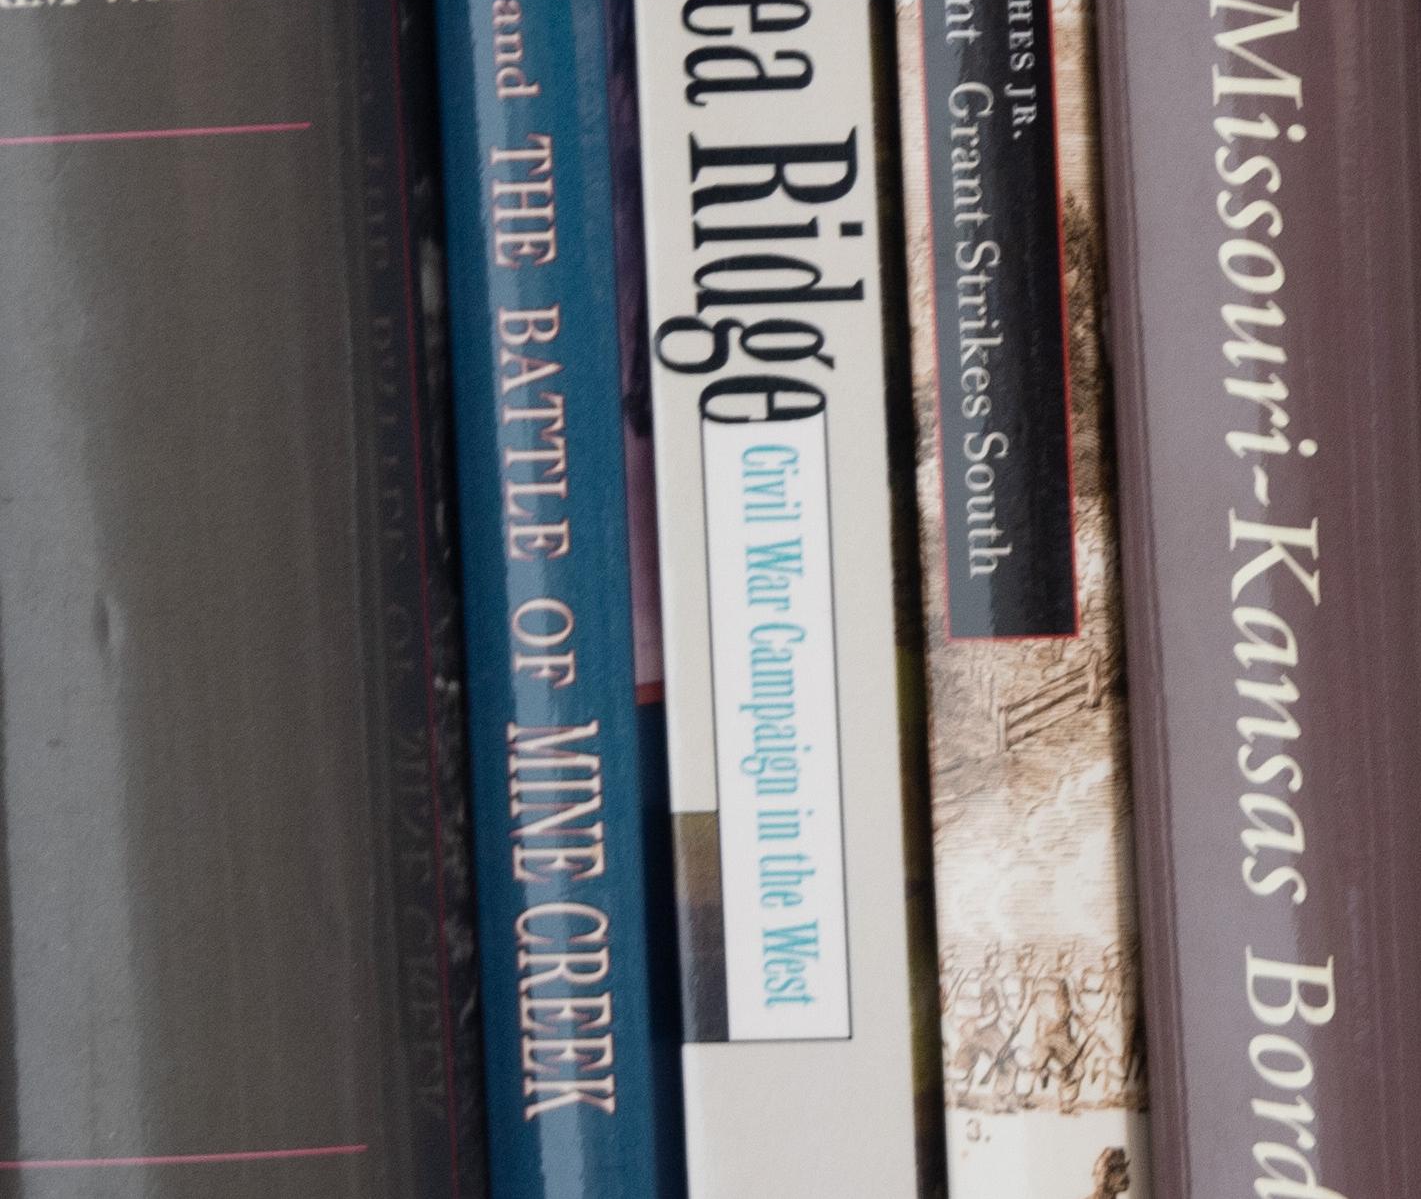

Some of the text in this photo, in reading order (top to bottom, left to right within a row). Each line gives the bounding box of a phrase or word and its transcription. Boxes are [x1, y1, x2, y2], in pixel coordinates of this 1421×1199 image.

[947, 82, 994, 230] Grant
[1009, 80, 1038, 140] JR.
[489, 133, 557, 269] THE
[654, 126, 866, 424] Ridge
[954, 238, 1005, 420] Strikes
[498, 302, 571, 563] BATTLE
[962, 432, 1014, 580] South
[510, 597, 577, 689] OF
[505, 721, 606, 883] MINE
[739, 442, 822, 1008] Civil War Campaign in the West
[515, 902, 616, 1121] CREEK
